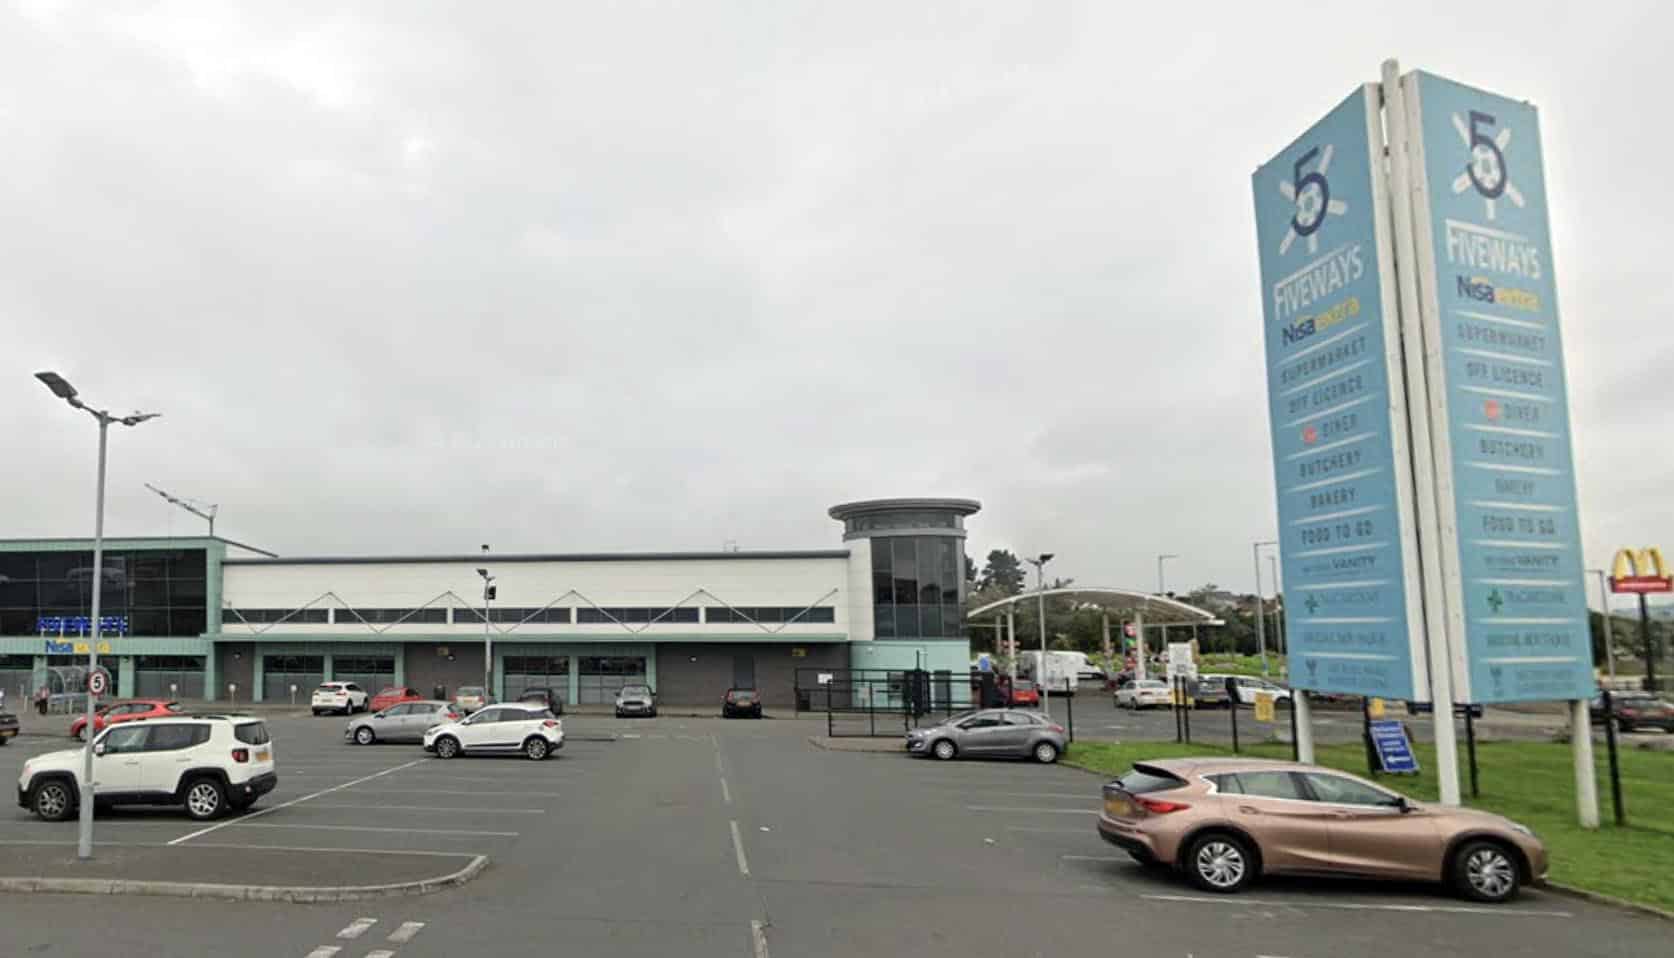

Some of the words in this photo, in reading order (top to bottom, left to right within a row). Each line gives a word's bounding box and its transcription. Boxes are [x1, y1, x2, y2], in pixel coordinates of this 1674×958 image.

[1446, 219, 1541, 279] FIVEWAYS
[1273, 243, 1364, 320] FIVEWAYS
[1281, 336, 1366, 384] SUPERMARKET
[1300, 450, 1361, 477] BUTCHERY
[1310, 487, 1356, 509] BAKERY
[1301, 527, 1330, 545] FOOD
[1335, 523, 1351, 539] TO
[1355, 519, 1373, 536] GO
[93, 675, 102, 690] 5
